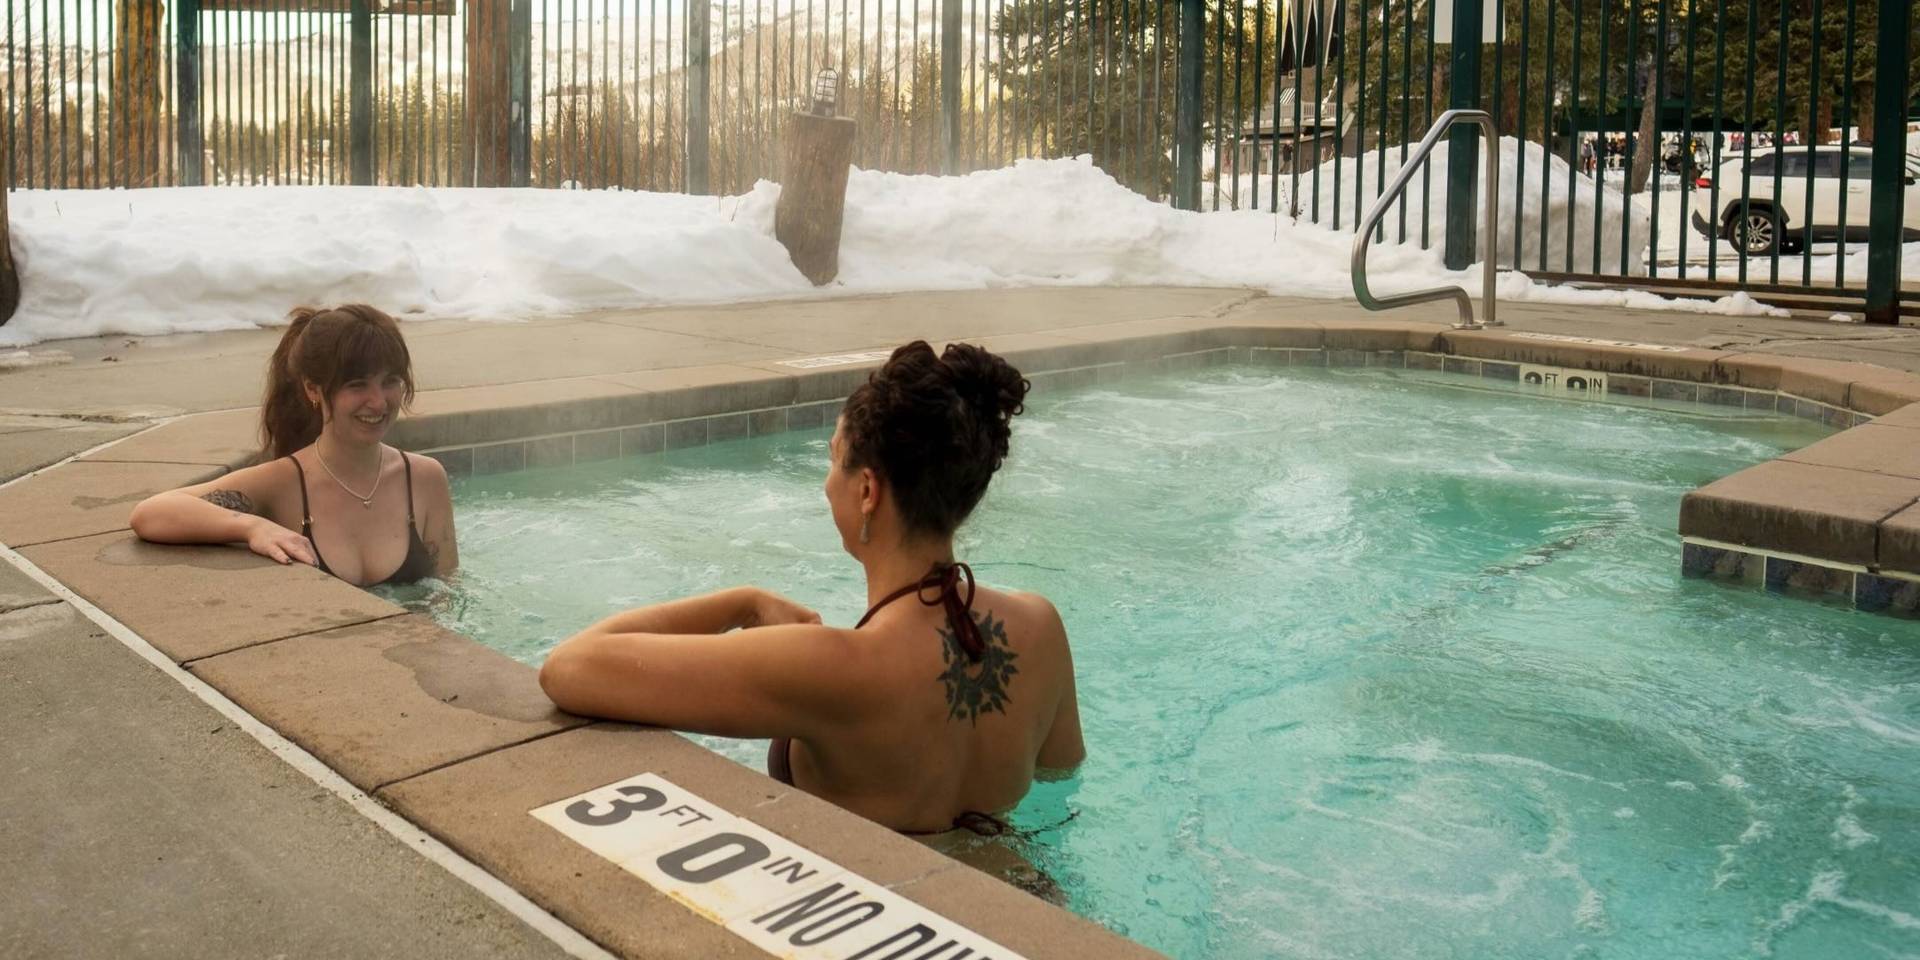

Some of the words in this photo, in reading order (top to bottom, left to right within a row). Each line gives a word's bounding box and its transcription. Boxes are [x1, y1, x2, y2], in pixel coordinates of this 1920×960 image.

[1545, 373, 1559, 385] FT
[1589, 378, 1602, 389] IN
[564, 785, 667, 826] 3
[659, 805, 712, 827] FT
[656, 832, 771, 883] 0
[762, 855, 817, 883] IN
[750, 883, 885, 947] NO
